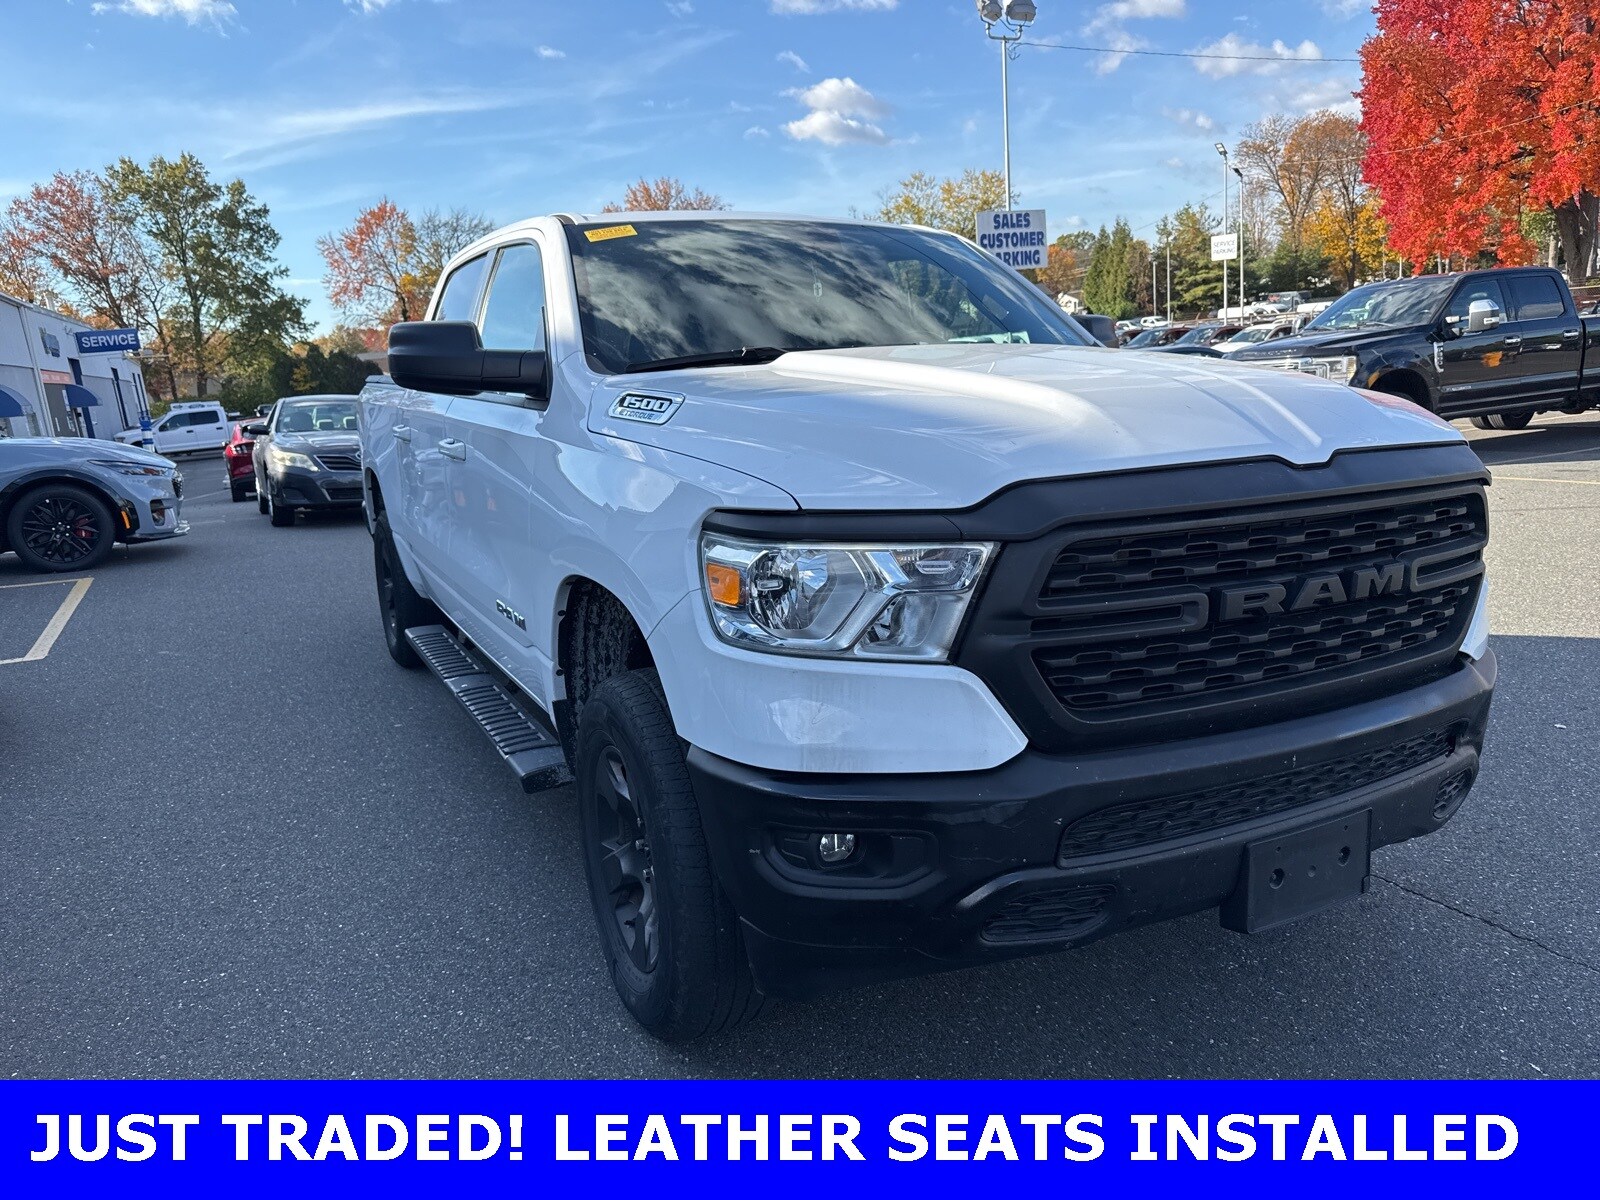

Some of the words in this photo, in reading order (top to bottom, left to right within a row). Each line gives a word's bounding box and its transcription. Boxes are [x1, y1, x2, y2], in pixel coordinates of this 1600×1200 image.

[993, 212, 1031, 229] SALES
[980, 231, 1045, 249] CUSTOMER
[995, 250, 1041, 266] RKING
[81, 333, 137, 348] SERVICE
[623, 396, 671, 412] 1500
[1219, 561, 1405, 622] RAM
